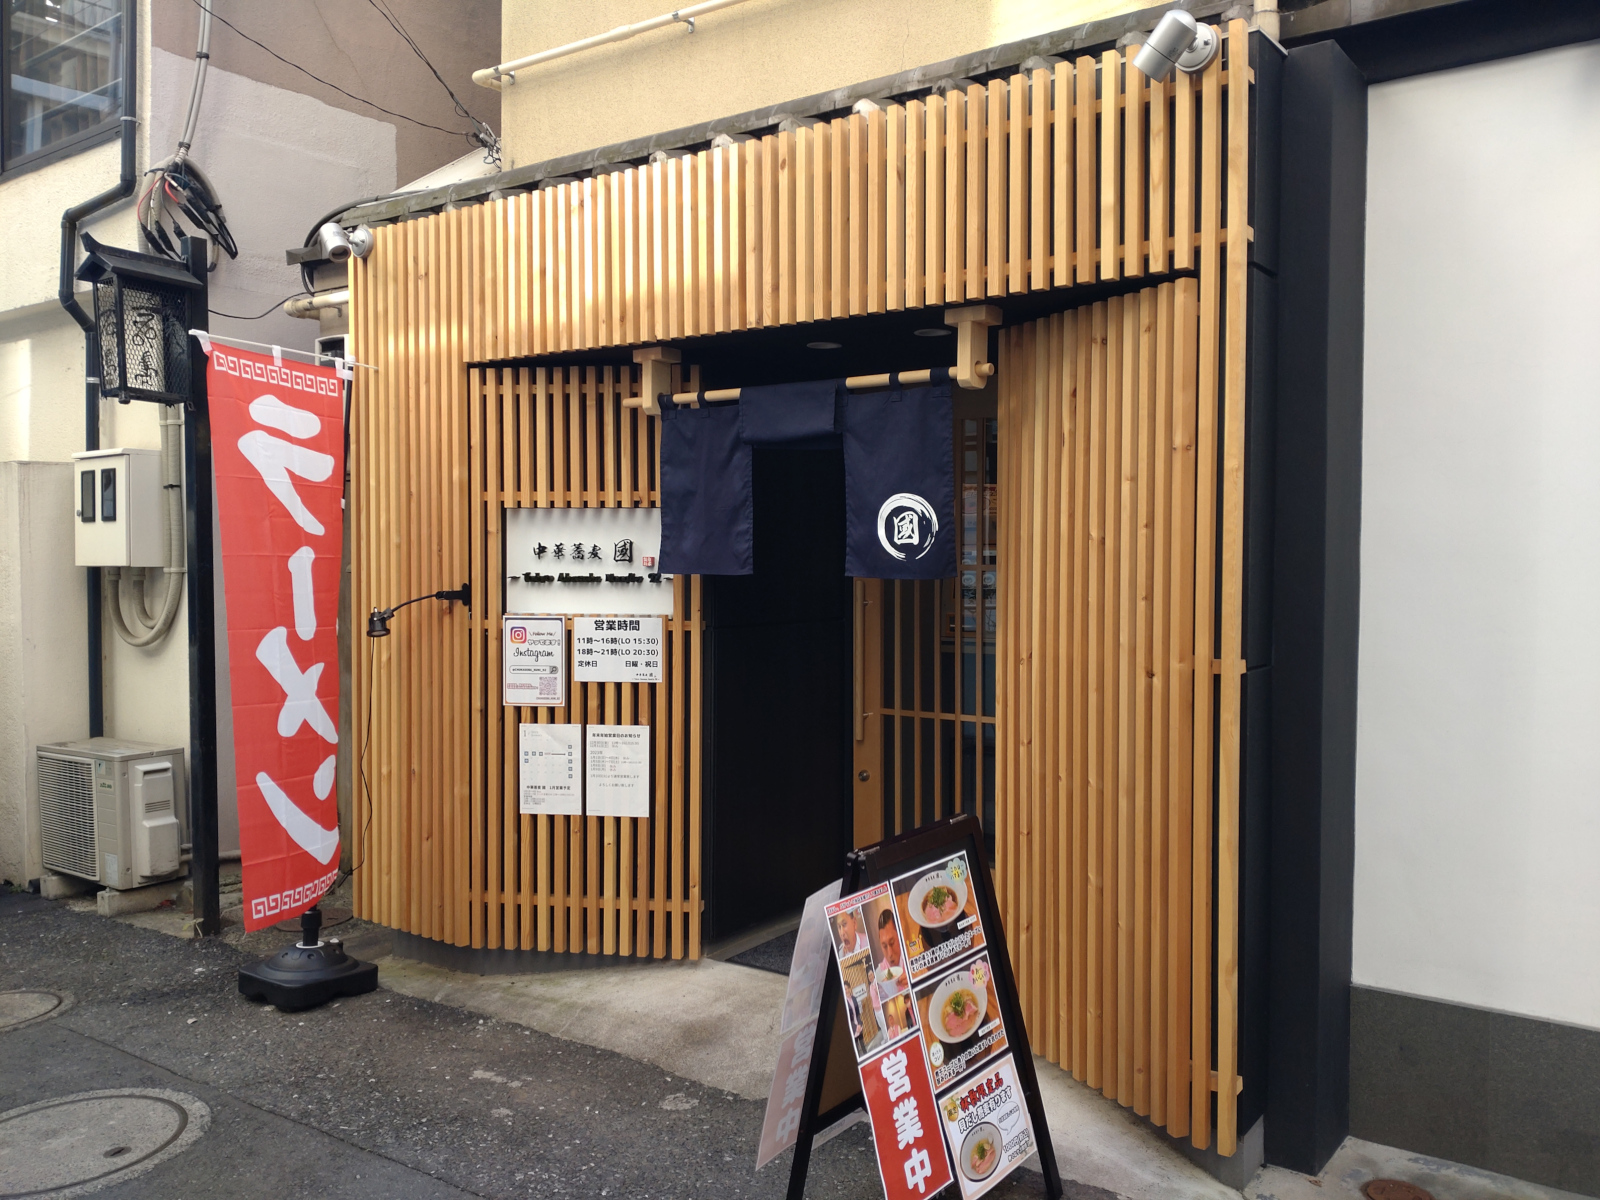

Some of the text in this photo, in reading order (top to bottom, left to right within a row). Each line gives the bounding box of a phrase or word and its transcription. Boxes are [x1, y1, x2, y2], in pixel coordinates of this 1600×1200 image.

[894, 511, 920, 545] 國
[533, 542, 602, 560] 中華蕎麦
[237, 394, 339, 865] ラーメン
[594, 620, 640, 631] 営業時間
[633, 637, 659, 645] 15:30)
[513, 647, 554, 662] Instagram
[633, 648, 659, 656] 20:30)
[960, 1072, 1004, 1113] 杯数限定品
[881, 1049, 932, 1193] 営業中
